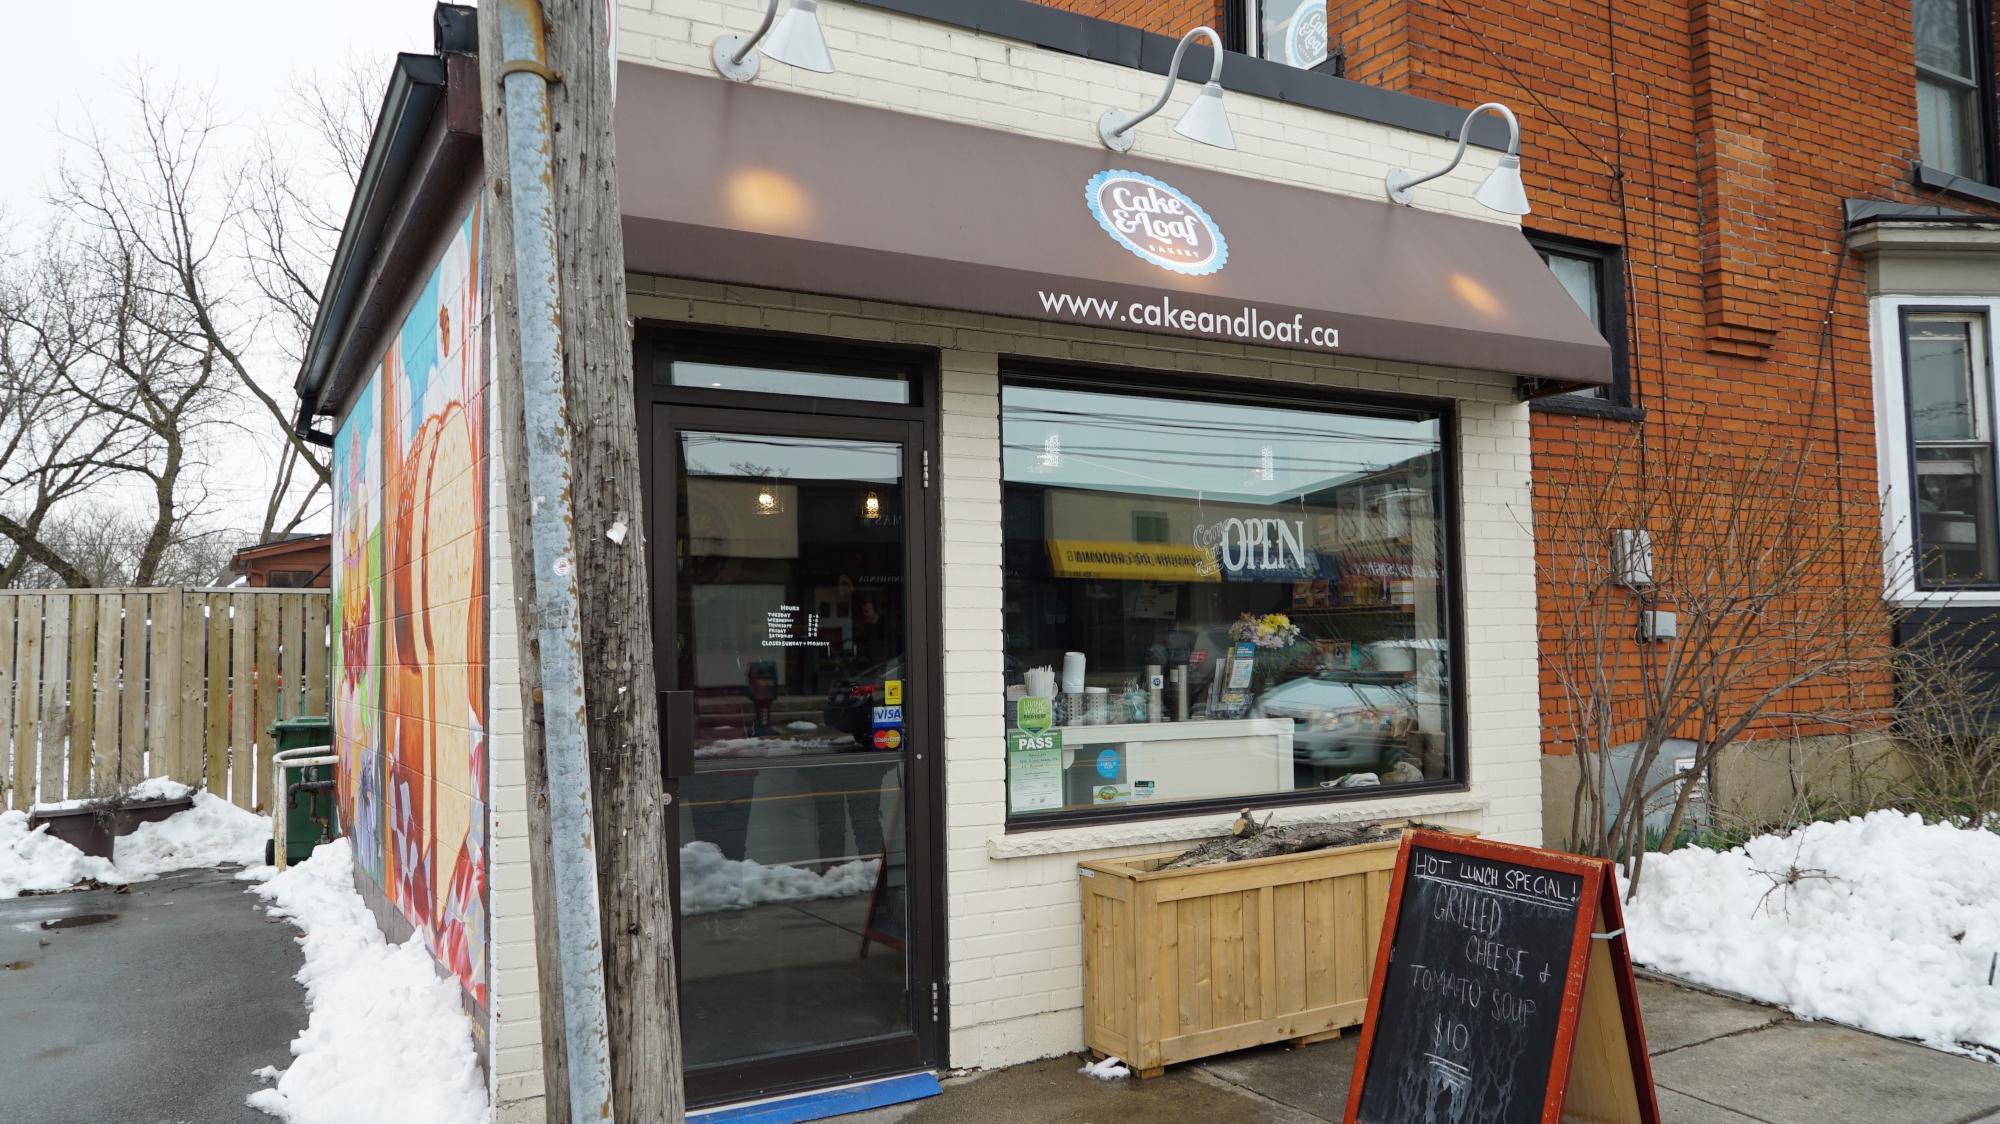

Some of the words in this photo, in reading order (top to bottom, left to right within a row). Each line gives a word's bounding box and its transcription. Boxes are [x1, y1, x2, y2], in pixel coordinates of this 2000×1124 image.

[1113, 187, 1184, 215] Cake
[1112, 209, 1136, 233] &
[1135, 212, 1198, 246] Loaf
[1148, 244, 1199, 258] BAKERY
[1038, 291, 1339, 348] www.cakeandloaf.ca
[1220, 518, 1306, 571] OPEN
[876, 709, 901, 719] VISA
[1018, 737, 1054, 750] PASS
[1415, 852, 1452, 876] HOT
[1460, 862, 1499, 887] LUNCH
[1433, 885, 1502, 935] GRILLED
[1465, 935, 1529, 978] CHEESE
[1410, 964, 1481, 1008] TOMATO
[1491, 988, 1536, 1027] SOUP
[1434, 1013, 1469, 1053] $10
